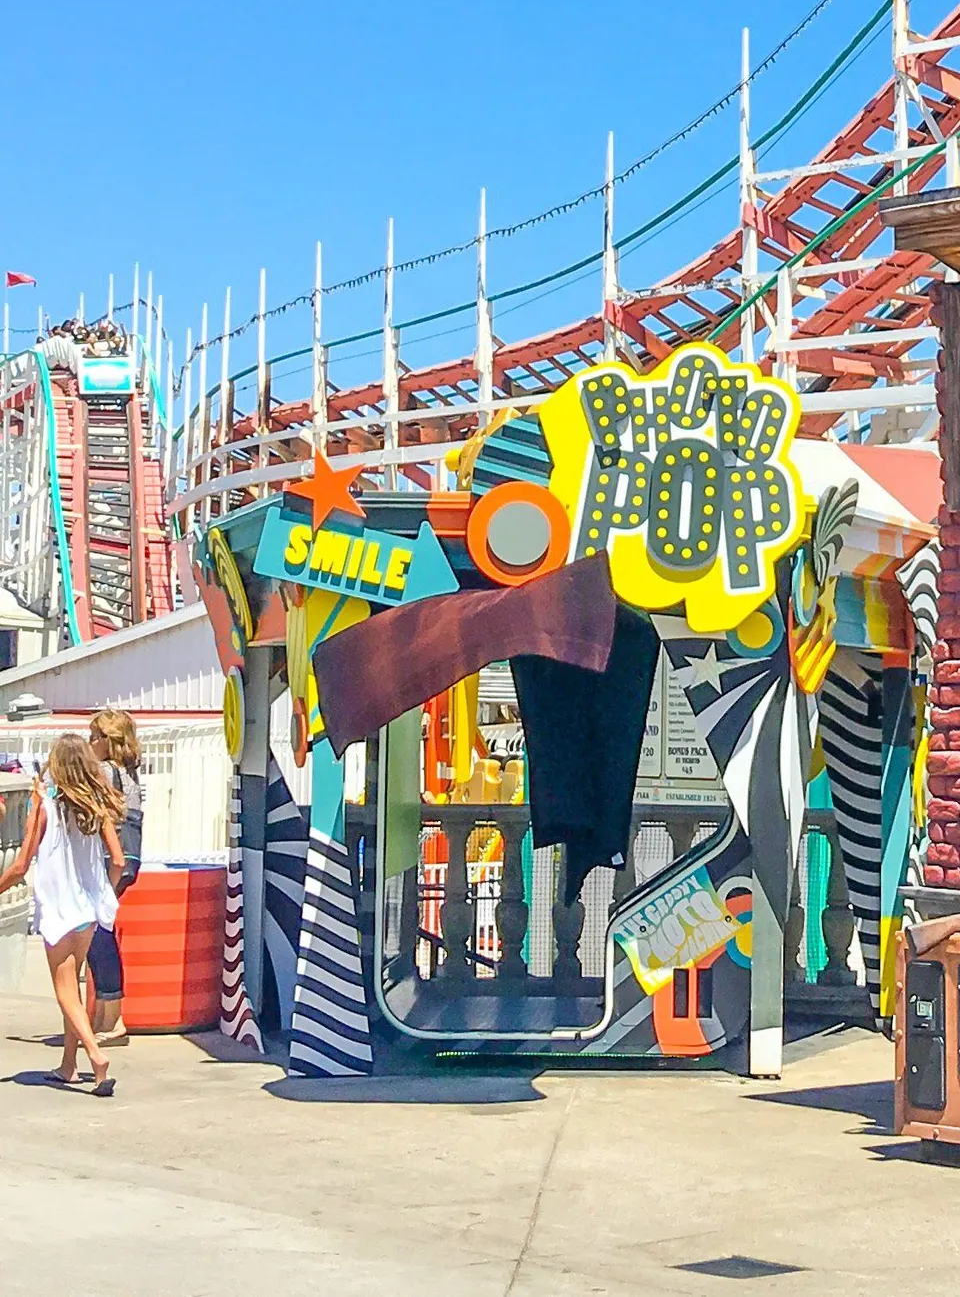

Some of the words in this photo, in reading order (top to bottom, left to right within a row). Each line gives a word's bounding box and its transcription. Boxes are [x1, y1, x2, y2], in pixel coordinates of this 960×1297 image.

[581, 355, 787, 463] PHOTO
[284, 524, 412, 591] SMILE
[575, 438, 791, 590] POP
